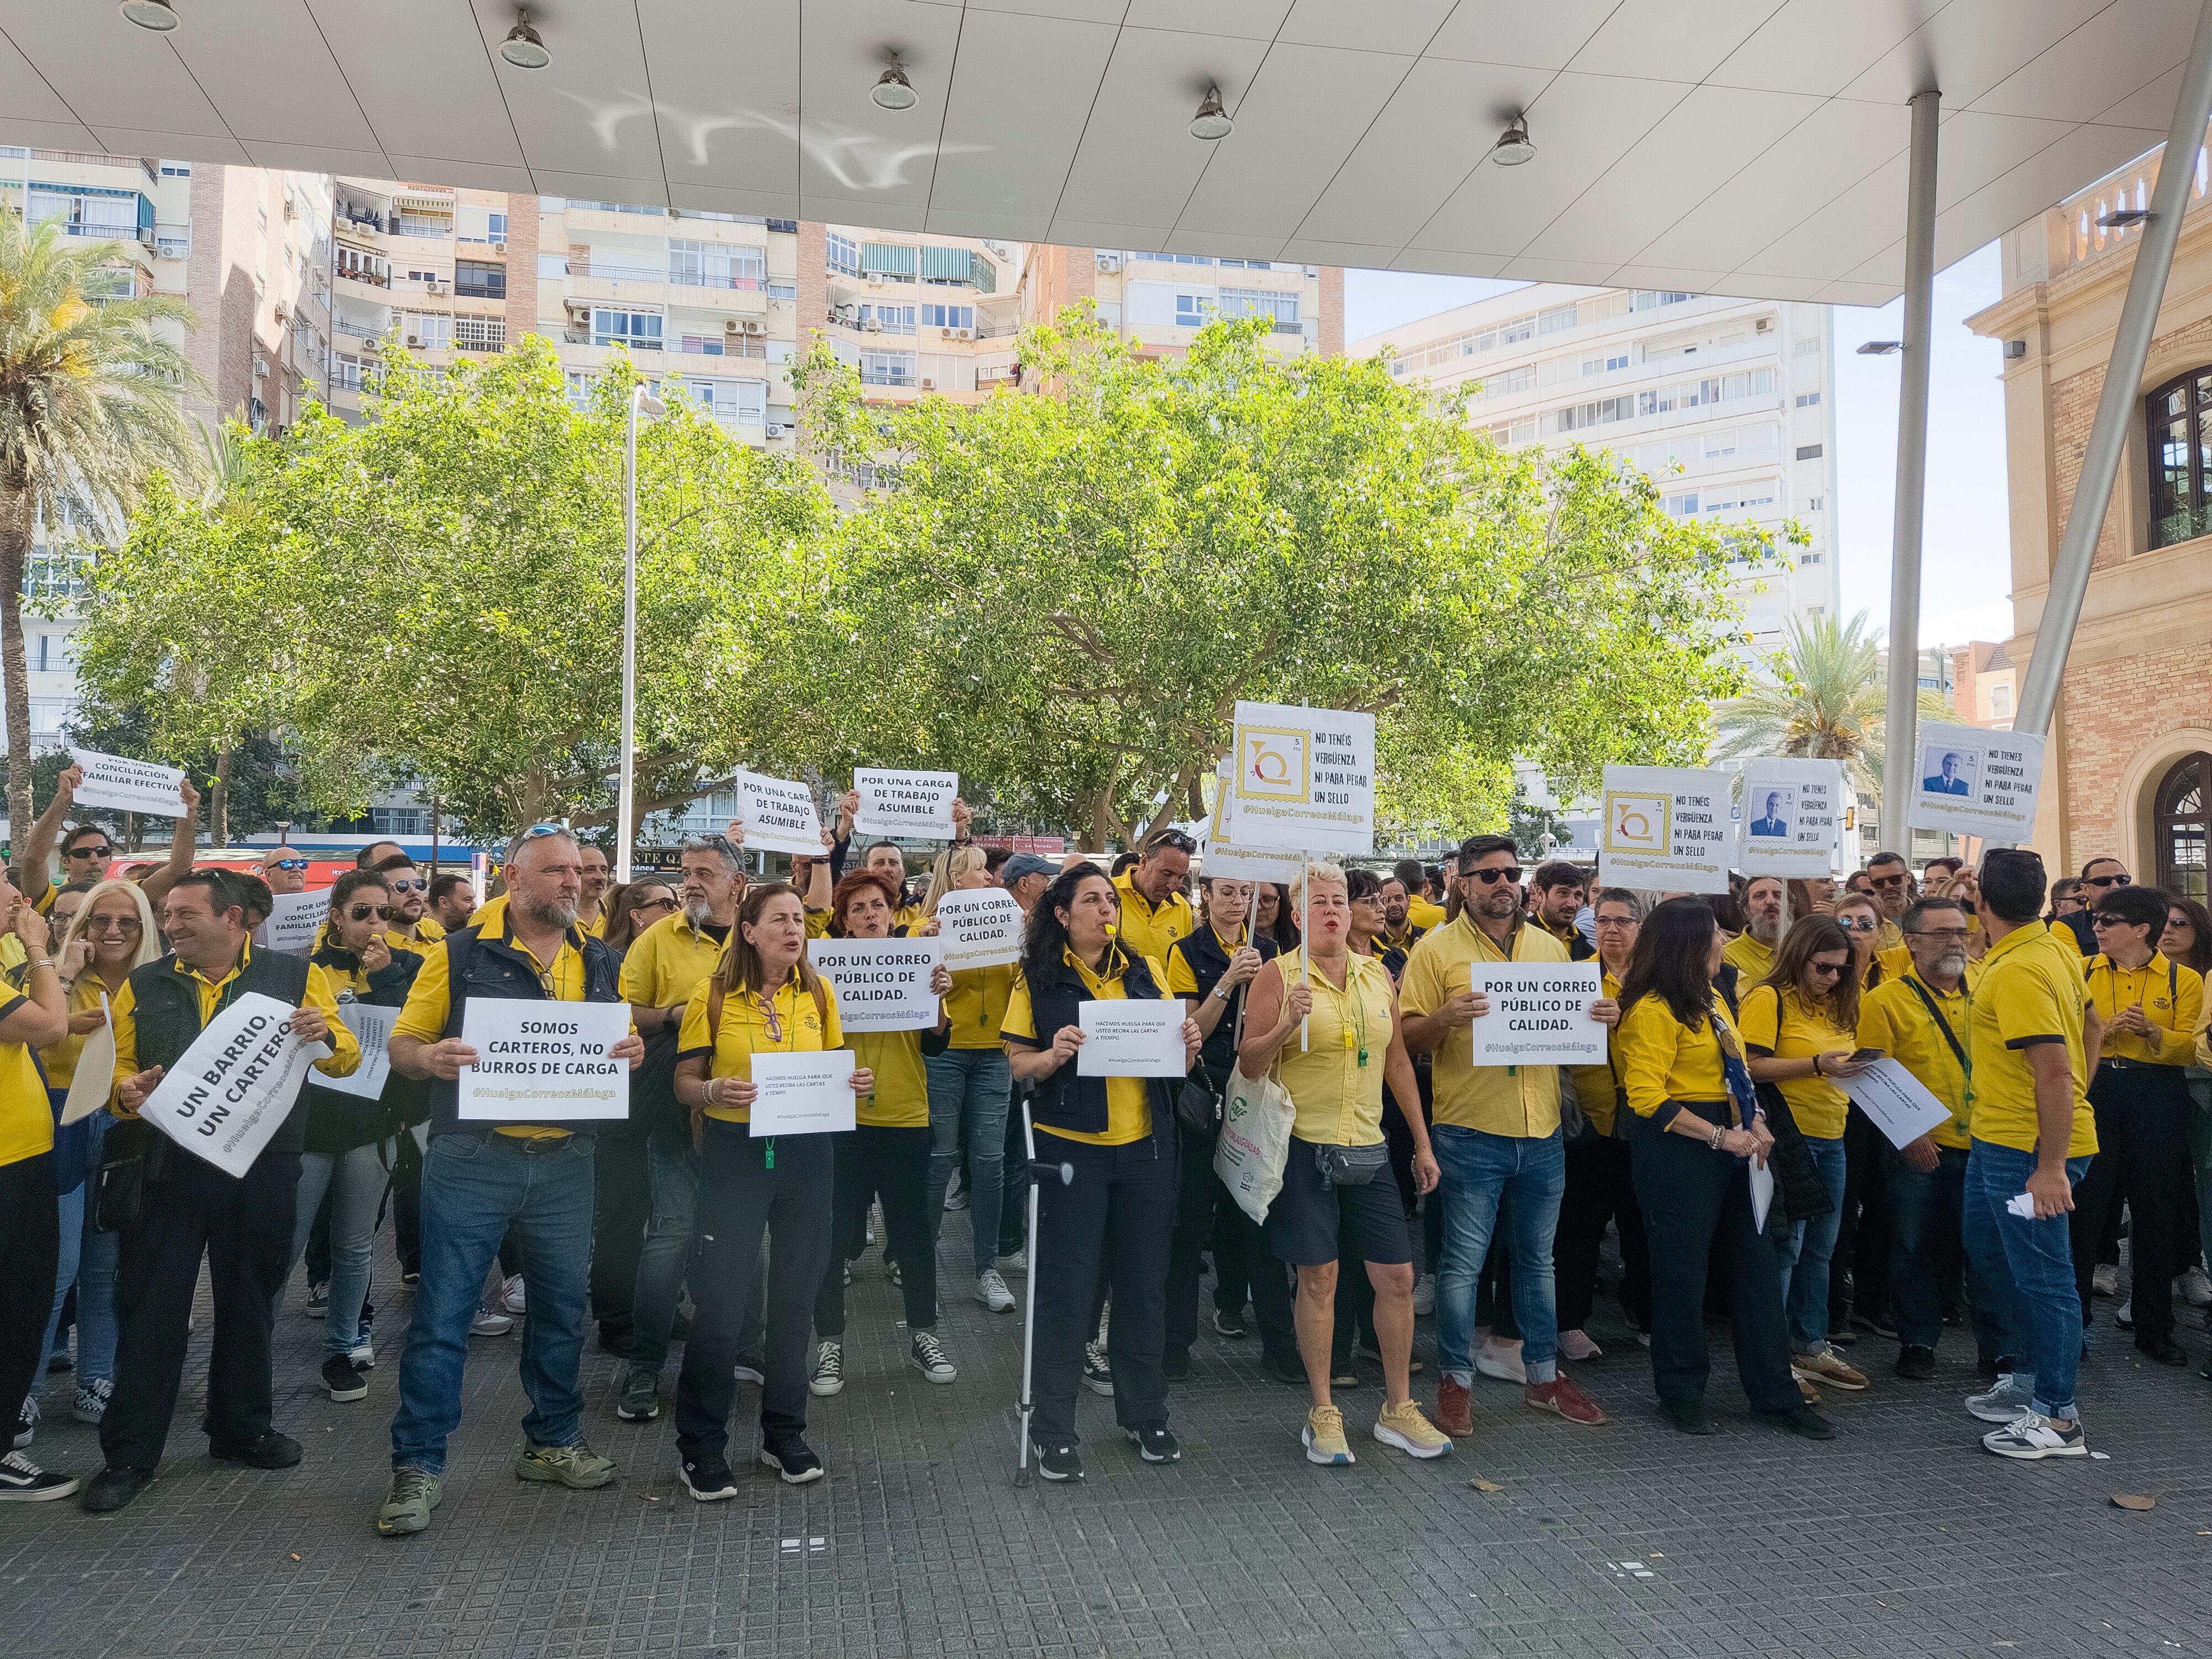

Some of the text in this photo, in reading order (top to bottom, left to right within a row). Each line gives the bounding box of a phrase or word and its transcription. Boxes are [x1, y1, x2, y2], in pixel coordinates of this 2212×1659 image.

[1316, 733, 1352, 746] NO TENÉIS
[1316, 752, 1355, 766] VERGÜENZA
[1989, 750, 2022, 761] NO TIENES
[95, 763, 169, 779] CONCILIACIÓN
[1988, 765, 2023, 777] VERGÜENZA
[83, 771, 179, 791] FAMILIAR EFECTIVA
[915, 780, 952, 788] CARGA
[1315, 772, 1367, 787] NI PARA PEGAR
[744, 782, 812, 802] POR UNA CARG
[1803, 785, 1827, 794] NO TIENES
[1995, 780, 2011, 790] PARA
[2013, 782, 2032, 794] PEGAR
[891, 791, 939, 802] TRABAJO
[1315, 792, 1349, 804] UN SELLO
[1676, 795, 1709, 806] NO TENÉIS
[1984, 795, 2014, 806] UN SELLO
[757, 799, 810, 816] DE TRABAJO
[878, 804, 935, 815] ASUMIBLE
[1802, 800, 1827, 810] VERGÜENZA
[1244, 806, 1363, 824] #HuelgaCorreosMálaga
[1676, 812, 1713, 823] VERGÜENZA
[758, 815, 806, 830] ASUMIBLE
[1799, 817, 1832, 826] NI PARA PEGAR
[1674, 830, 1723, 842] NI PARA PEGAR
[1798, 832, 1819, 842] UN SELLO
[1674, 846, 1705, 856] UN SELLO
[285, 909, 328, 921] CONCILIAC
[940, 905, 961, 915] POR
[964, 903, 979, 912] UN
[276, 922, 317, 930] FAMILIAR
[953, 914, 1011, 928] PÚBLICO DE
[960, 930, 1007, 942] CALIDAD.
[819, 954, 931, 967] POR UN CORREO
[835, 971, 915, 984] PÚBLICO DE
[1485, 982, 1597, 992] POR UN CORREO
[843, 990, 907, 1001] CALIDAD.
[1501, 998, 1581, 1011] PÚBLICO DE
[841, 1010, 930, 1022] elgaCorreosMálaga
[521, 1021, 578, 1035] SOMOS
[1509, 1019, 1573, 1030] CALIDAD.
[489, 1041, 604, 1057] CARTEROS, NO
[1485, 1042, 1597, 1053] #HuelgaCorreosMálaga
[176, 1015, 275, 1118] UN BARRIO,
[366, 1048, 381, 1079] ACUMULANDO
[472, 1062, 618, 1075] BURROS DE CARGA
[197, 1021, 291, 1136] UN CARTERO
[473, 1088, 615, 1100] #HuelgaCorreosMálaga
[1870, 1065, 1921, 1111] ACEMOS HUELGA PARA QUE
[1876, 1074, 1890, 1088] RECIBA
[1897, 1094, 1911, 1108] CARTAS
